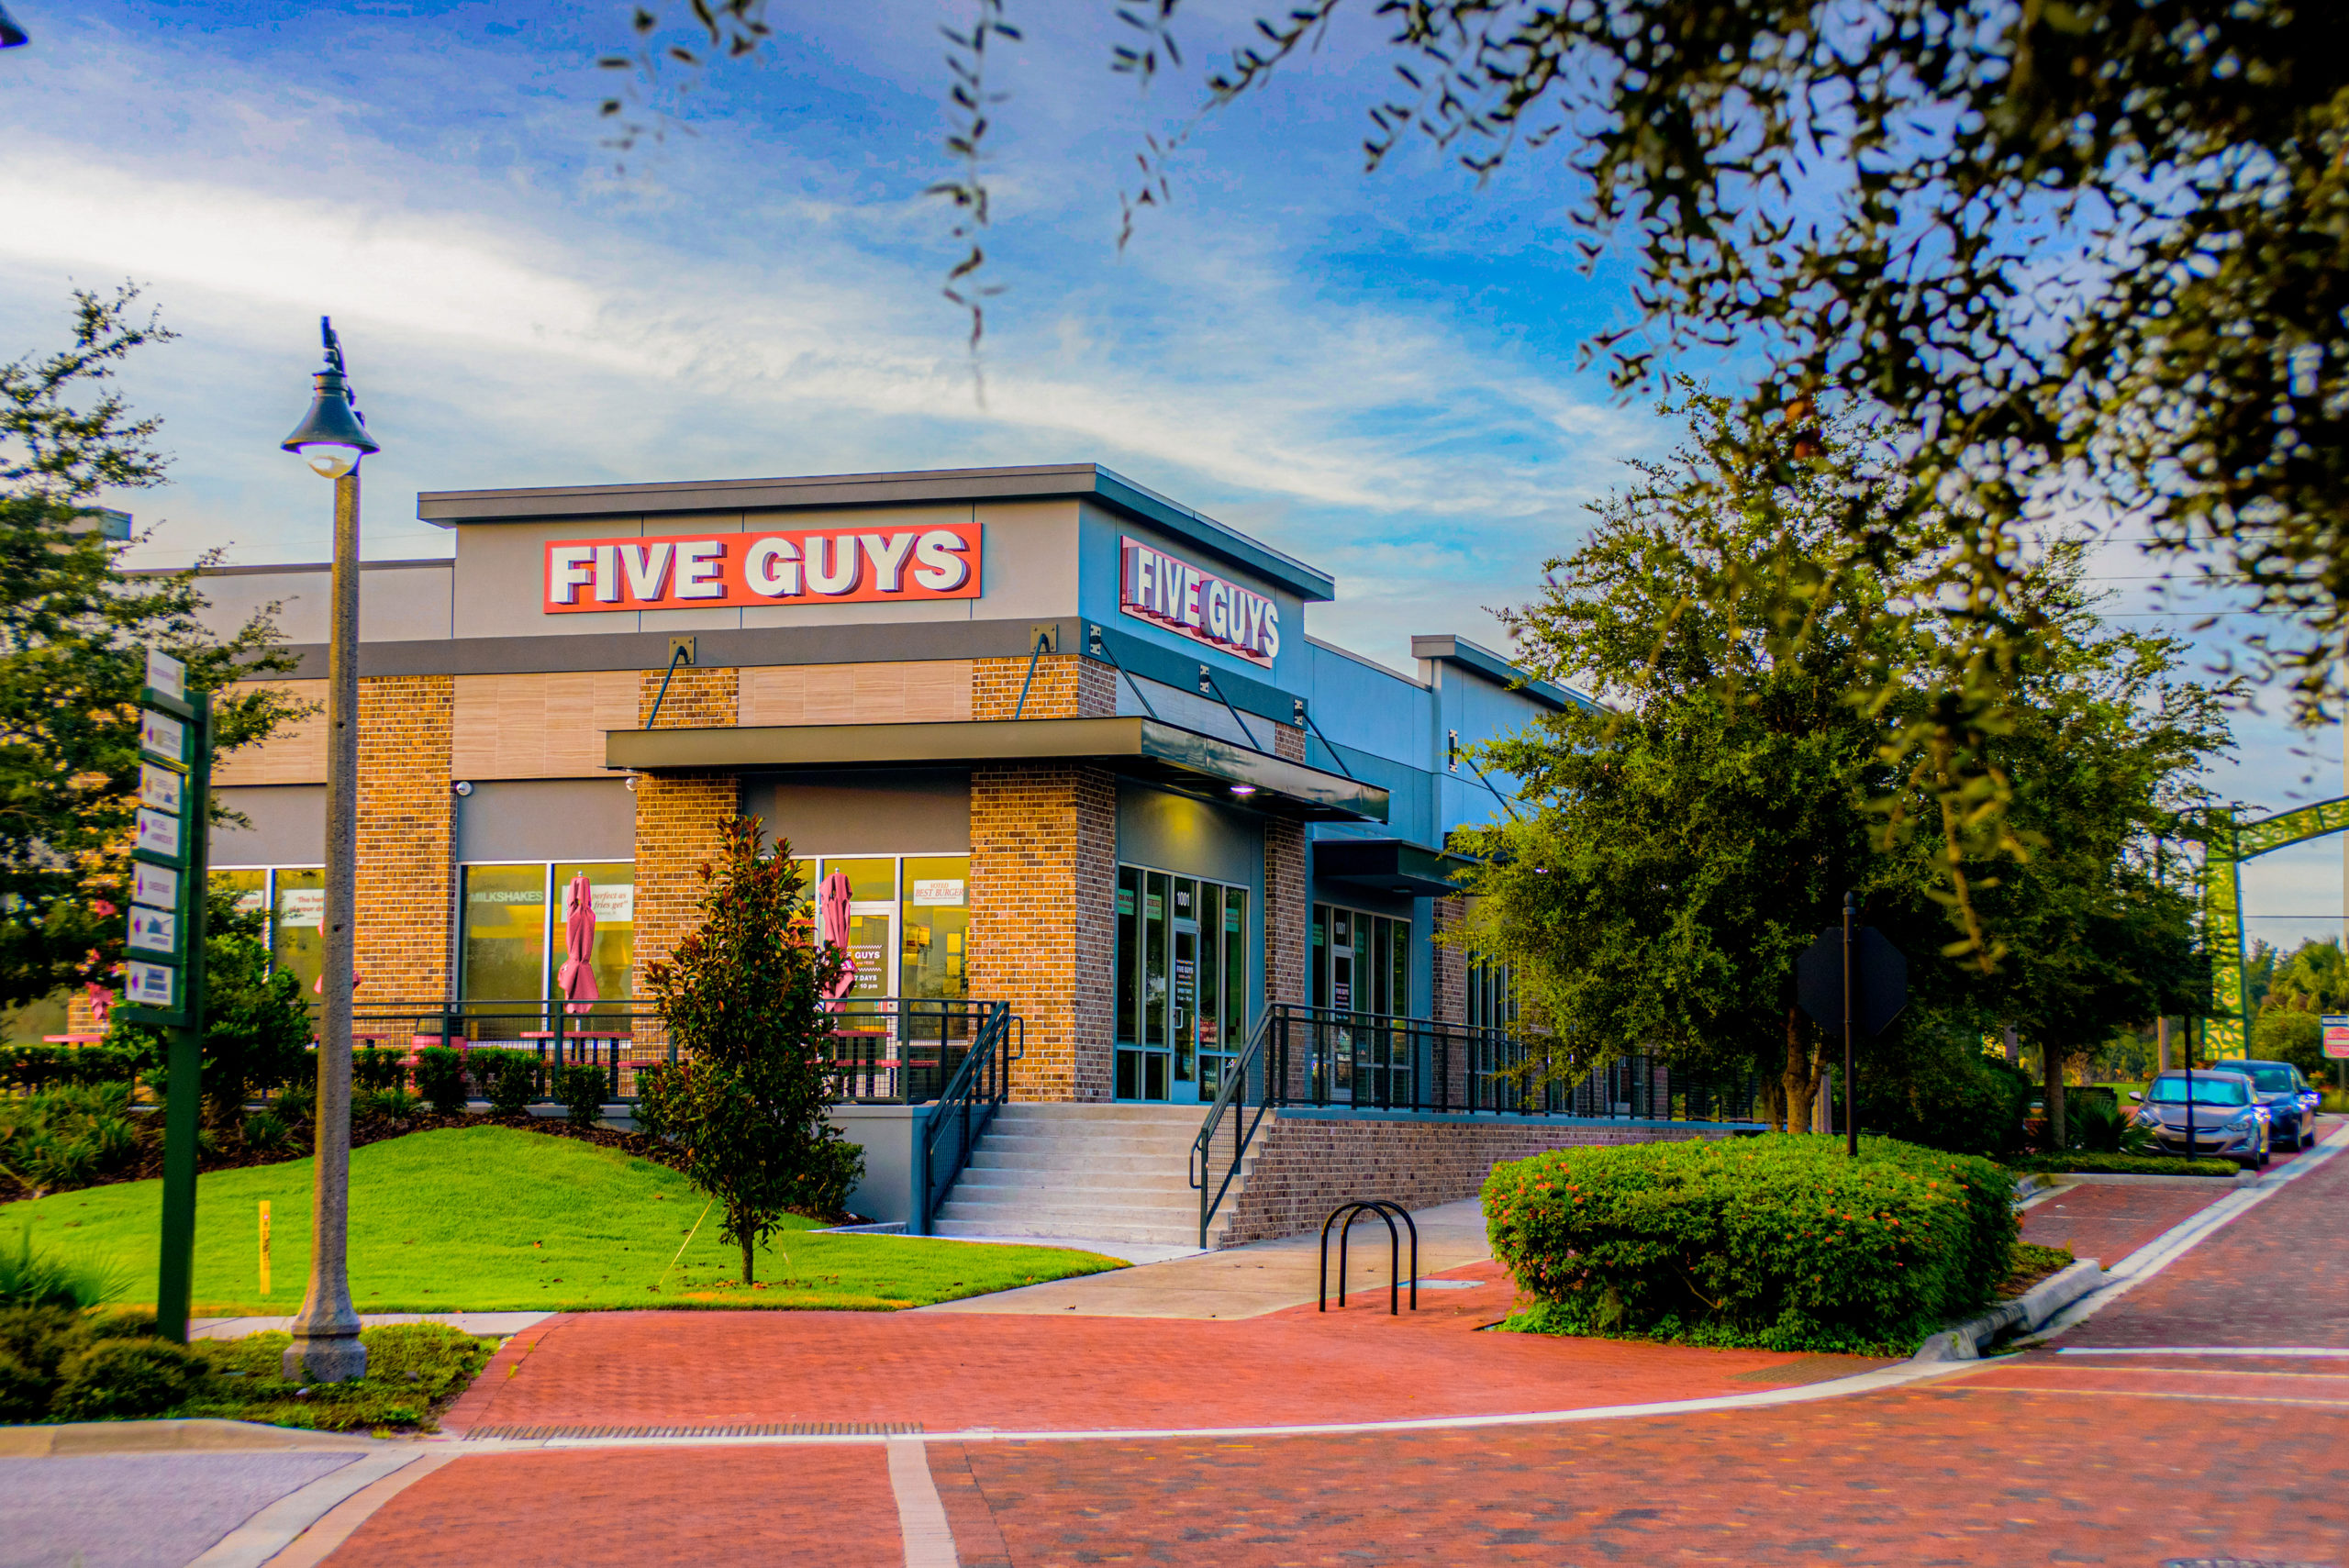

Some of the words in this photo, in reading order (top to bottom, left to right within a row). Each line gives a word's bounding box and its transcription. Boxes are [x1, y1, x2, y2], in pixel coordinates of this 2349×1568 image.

[551, 540, 726, 605] FIVE
[744, 529, 971, 598] GUYS
[1130, 546, 1200, 628] FIVE
[1202, 579, 1279, 658] GUYS
[470, 891, 543, 902] MILKSHAKES
[915, 888, 933, 897] BEST
[935, 887, 964, 896] BURGER
[1177, 891, 1189, 906] 1001
[854, 951, 881, 960] GUYS
